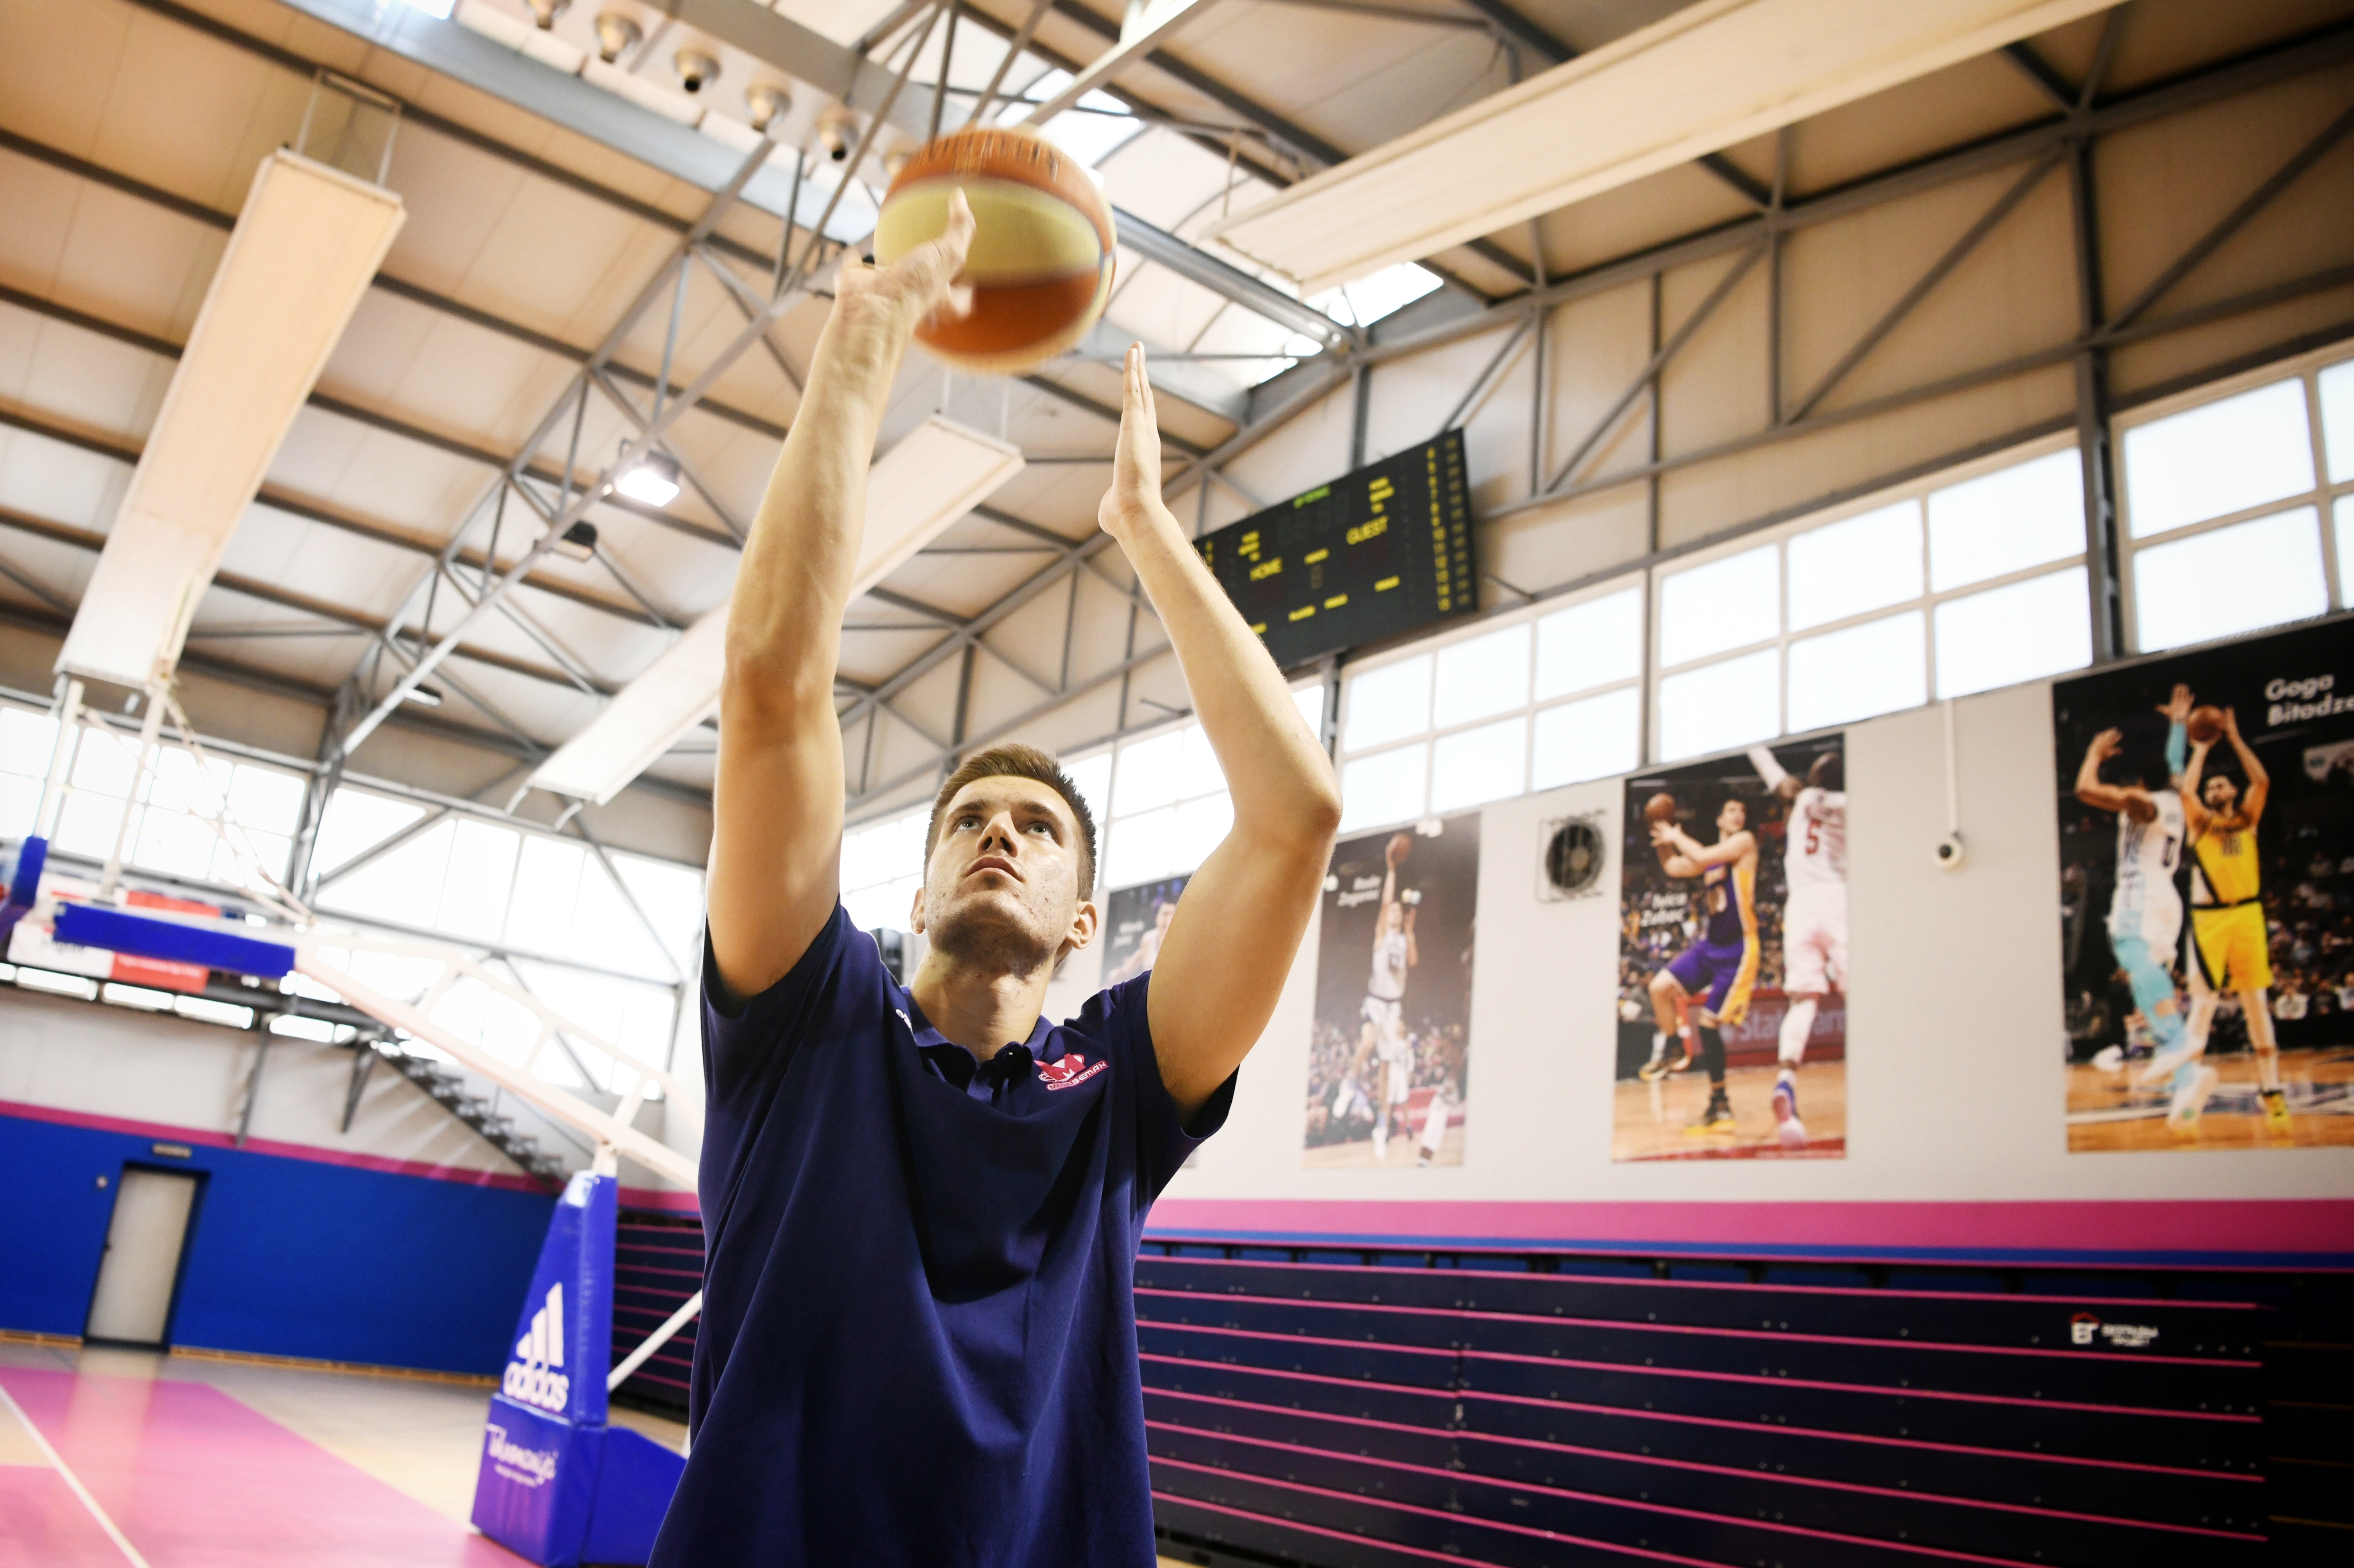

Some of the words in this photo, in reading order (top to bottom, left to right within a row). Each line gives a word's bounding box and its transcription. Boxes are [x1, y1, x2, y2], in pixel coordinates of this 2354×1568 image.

[1346, 515, 1389, 545] GUEST
[1250, 557, 1283, 581] HOME
[2265, 675, 2334, 701] Goga
[1071, 1062, 1107, 1085] BEMAX
[503, 1359, 569, 1412] adidas
